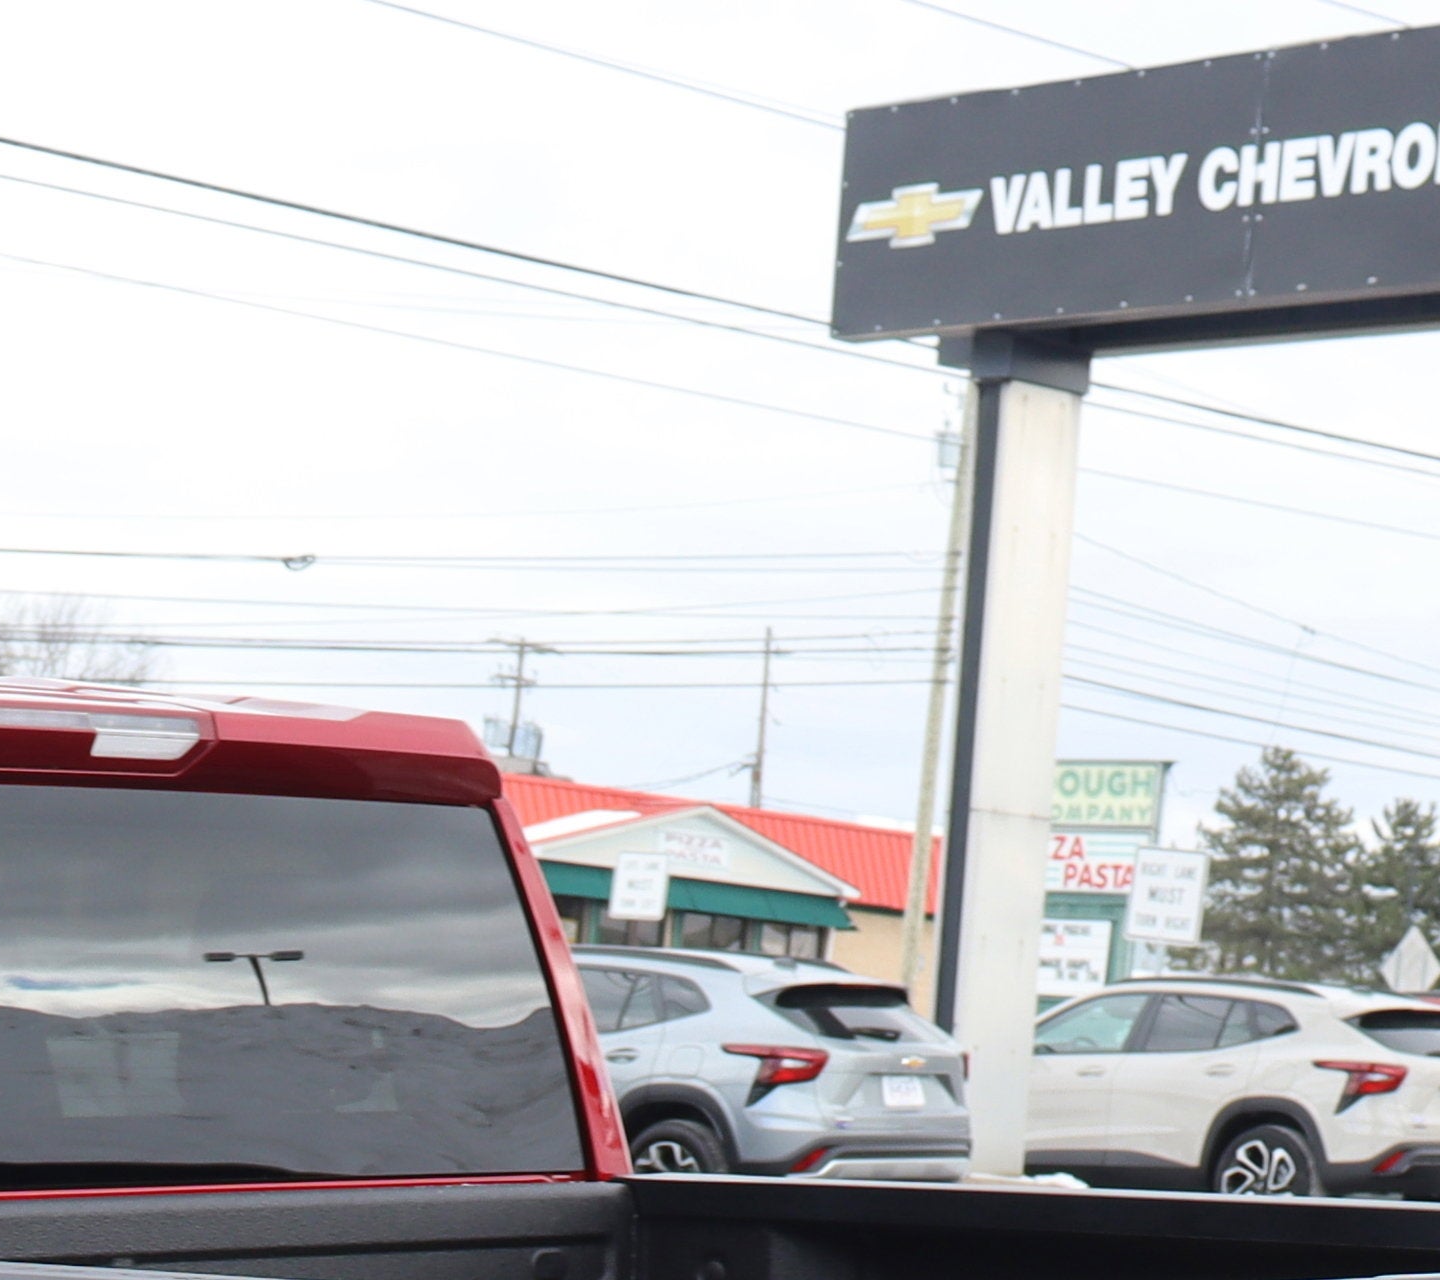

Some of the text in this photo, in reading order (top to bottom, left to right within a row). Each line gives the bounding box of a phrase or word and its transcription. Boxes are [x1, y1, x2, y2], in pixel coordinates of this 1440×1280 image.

[989, 152, 1188, 235] VALLEY
[1057, 769, 1153, 798] OUGH
[1063, 863, 1134, 889] PASTA
